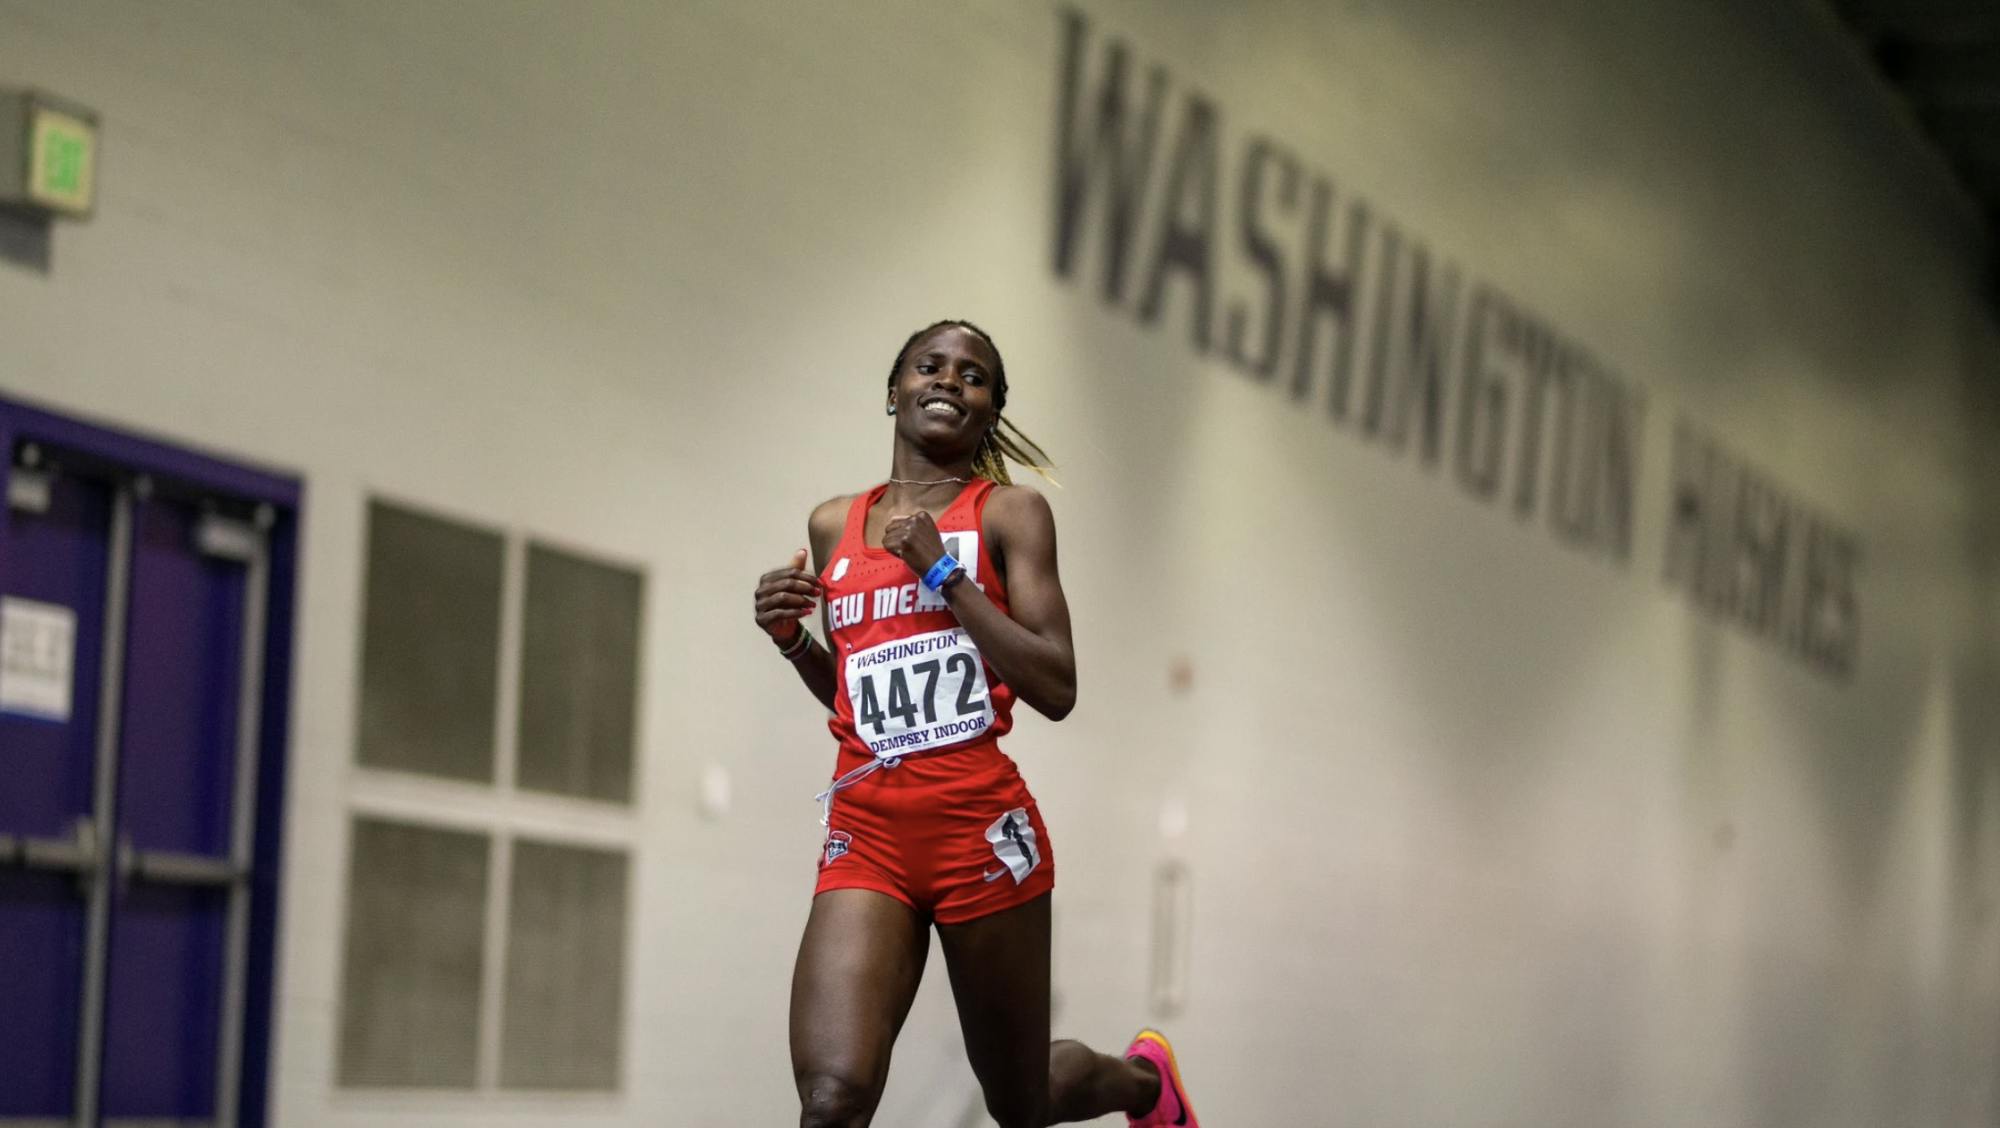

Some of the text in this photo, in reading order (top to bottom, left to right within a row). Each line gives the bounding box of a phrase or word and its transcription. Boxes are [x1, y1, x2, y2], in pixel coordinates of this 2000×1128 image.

[1054, 8, 1647, 565] WASHINGTON
[857, 634, 958, 669] WASHINGTON
[860, 652, 986, 735] 4472
[870, 730, 930, 753] DEMPSEY
[933, 716, 986, 739] INDOOR
